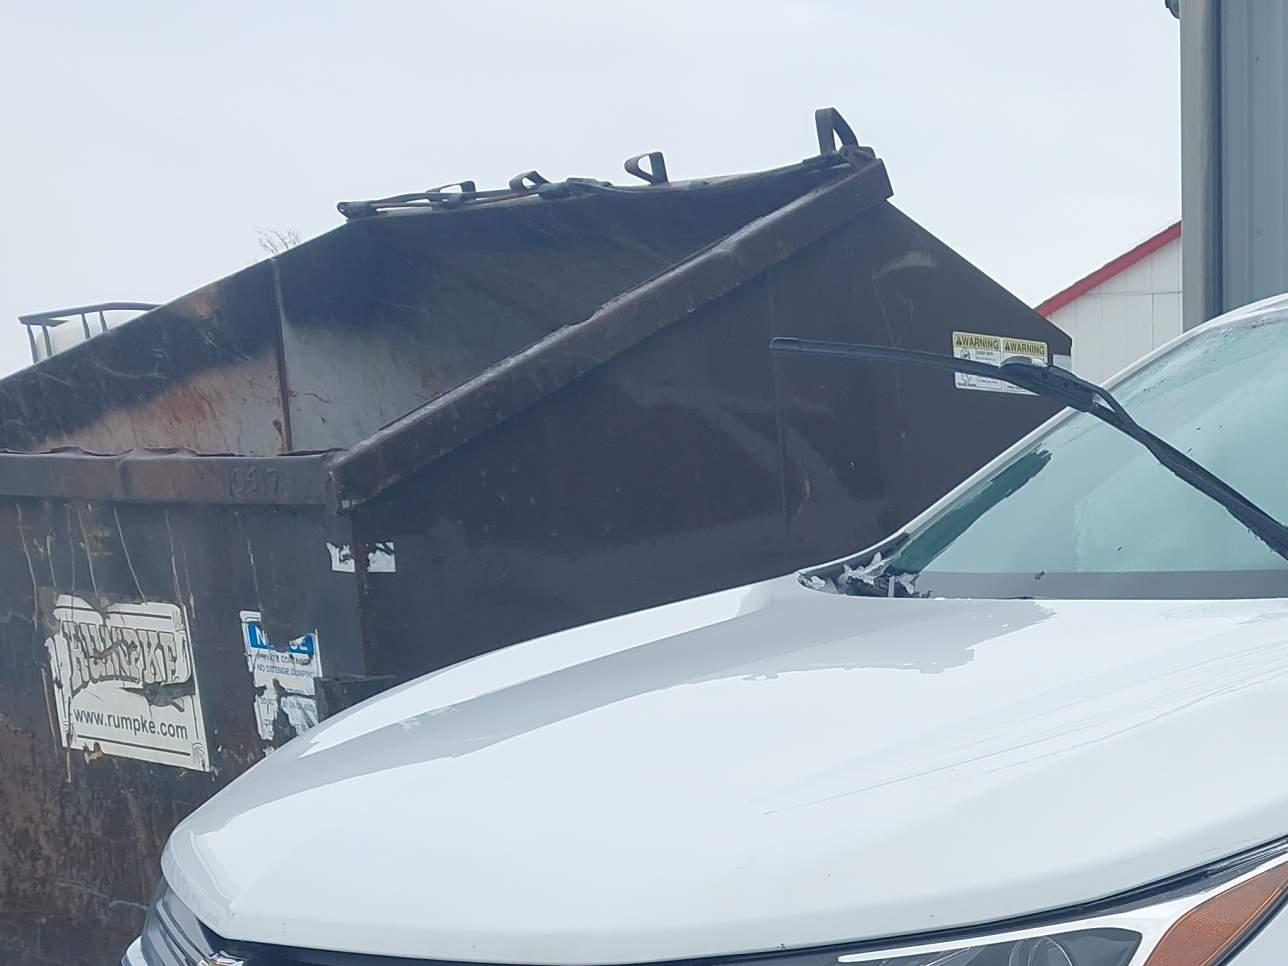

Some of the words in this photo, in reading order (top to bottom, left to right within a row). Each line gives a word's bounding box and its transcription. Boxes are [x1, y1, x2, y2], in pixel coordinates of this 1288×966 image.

[962, 336, 999, 350] WARNING
[1009, 341, 1045, 355] WARNING
[73, 708, 189, 740] www.rumpke.com
